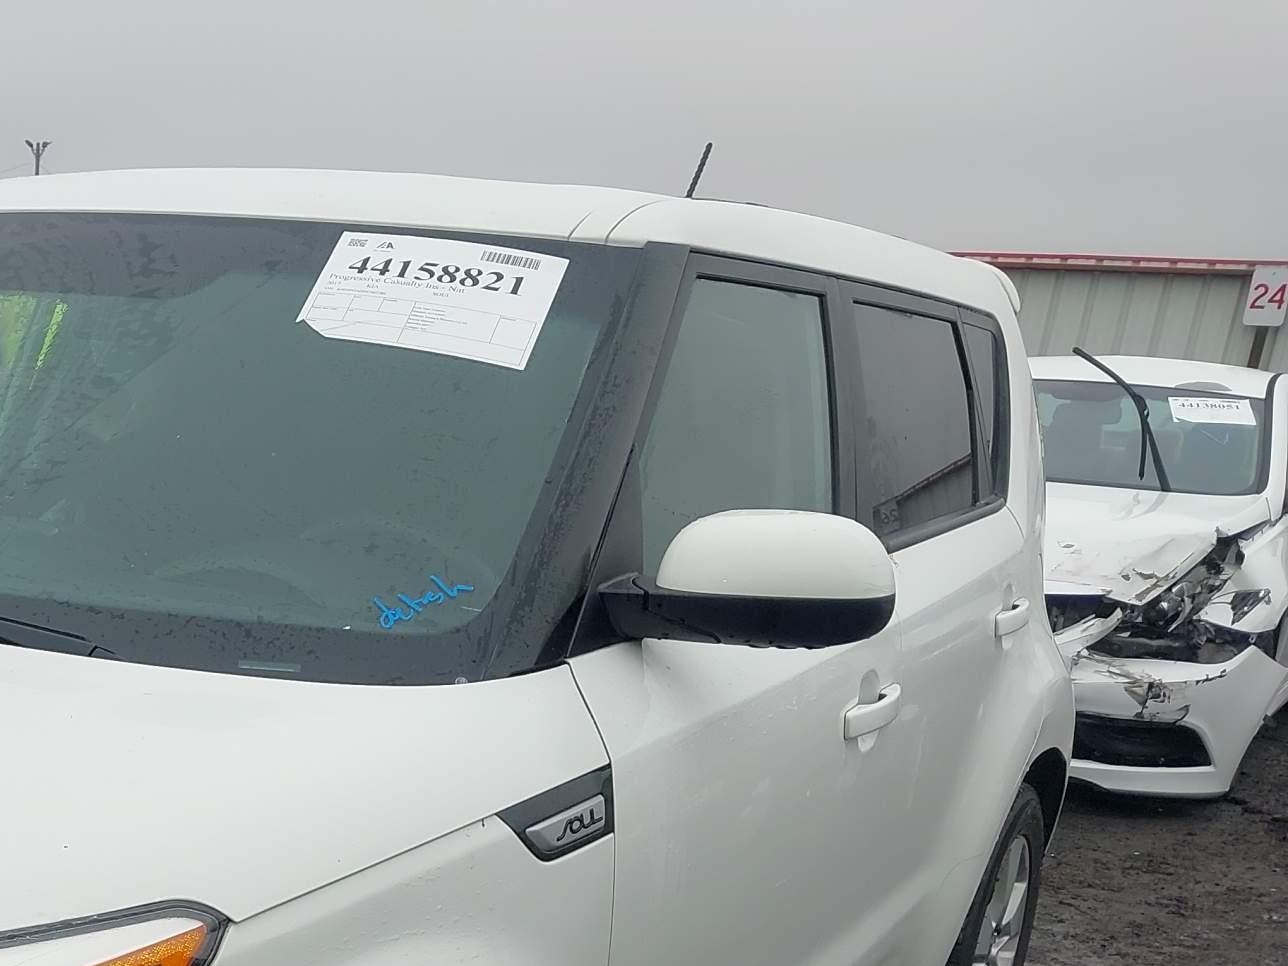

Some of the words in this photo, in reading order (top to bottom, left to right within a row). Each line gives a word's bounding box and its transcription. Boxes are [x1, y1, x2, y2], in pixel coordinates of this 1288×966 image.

[329, 273, 381, 284] Progressive
[383, 277, 423, 289] Casualty
[448, 285, 465, 294] Nat
[348, 255, 525, 297] 44158821
[1249, 283, 1287, 310] 24
